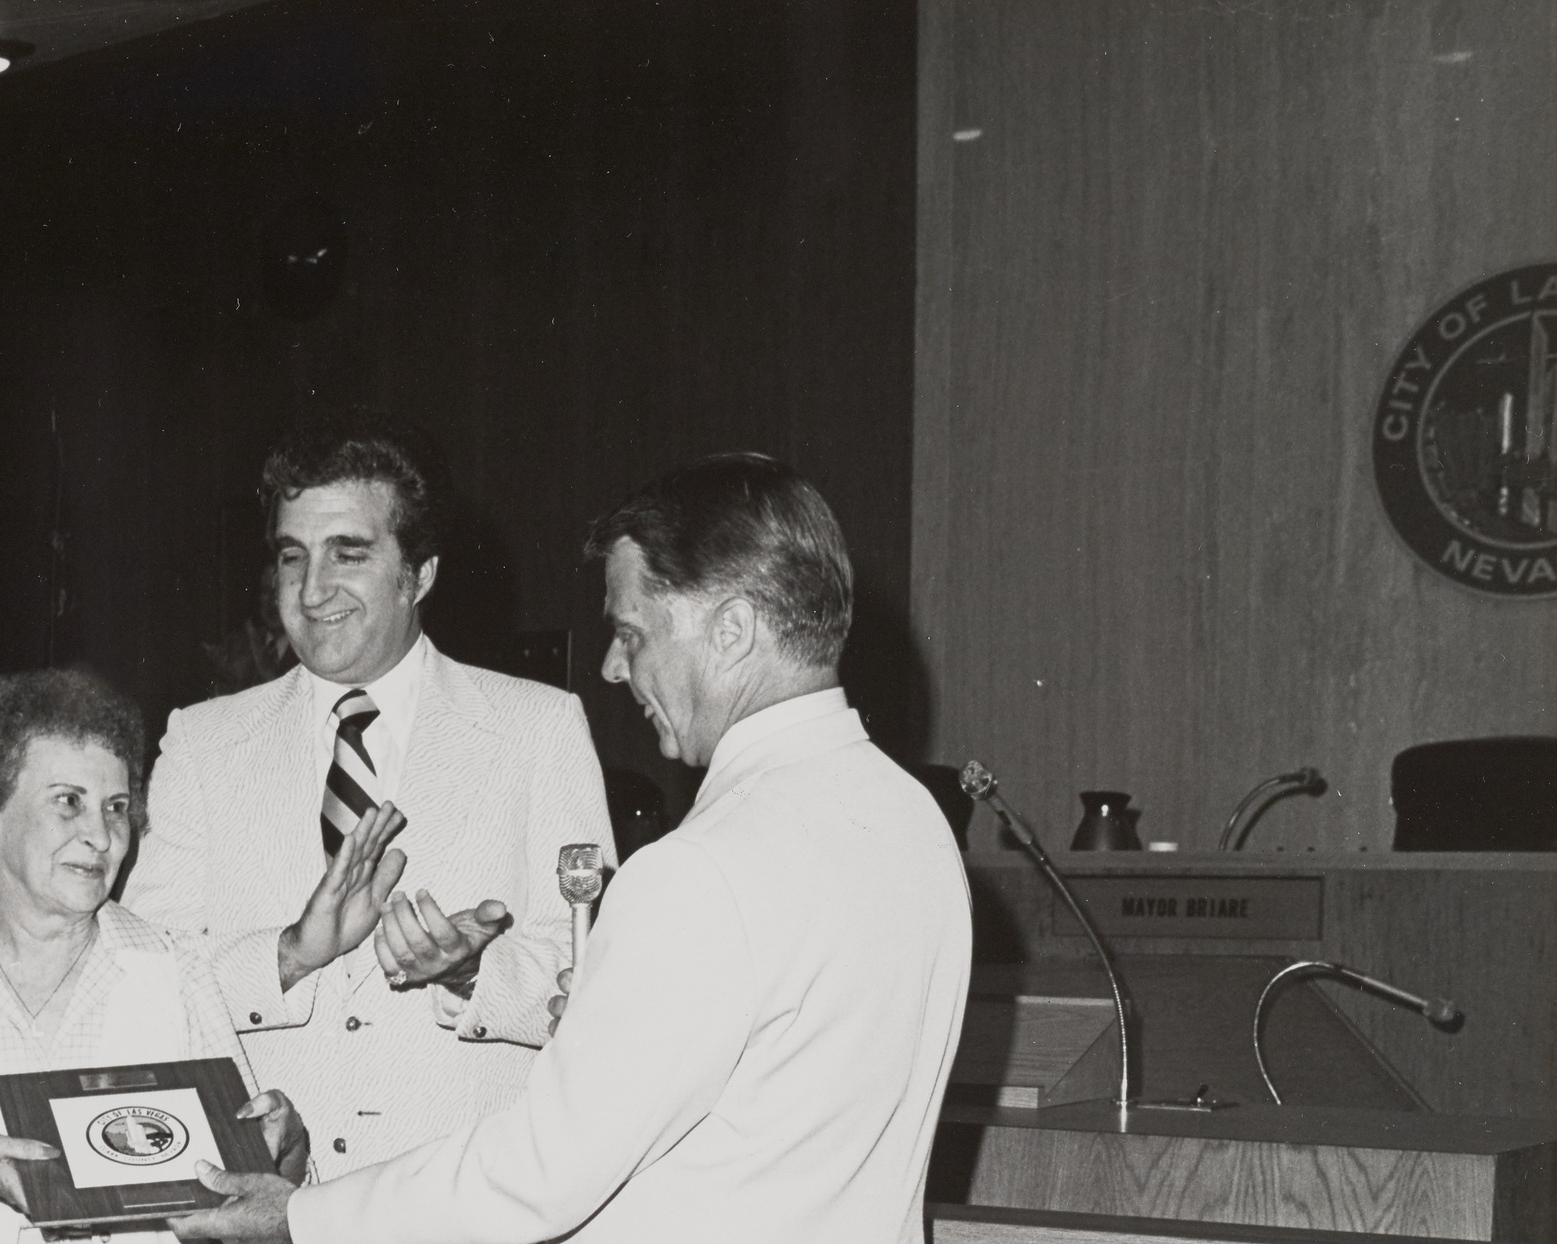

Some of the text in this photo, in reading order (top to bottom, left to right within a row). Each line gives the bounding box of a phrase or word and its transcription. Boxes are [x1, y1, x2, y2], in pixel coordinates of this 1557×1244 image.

[1382, 345, 1433, 441] CITY
[1439, 295, 1490, 341] OF
[1441, 540, 1557, 585] NEVA
[1122, 898, 1249, 918] MAYOR BRIARE
[146, 1110, 169, 1121] VEGAS
